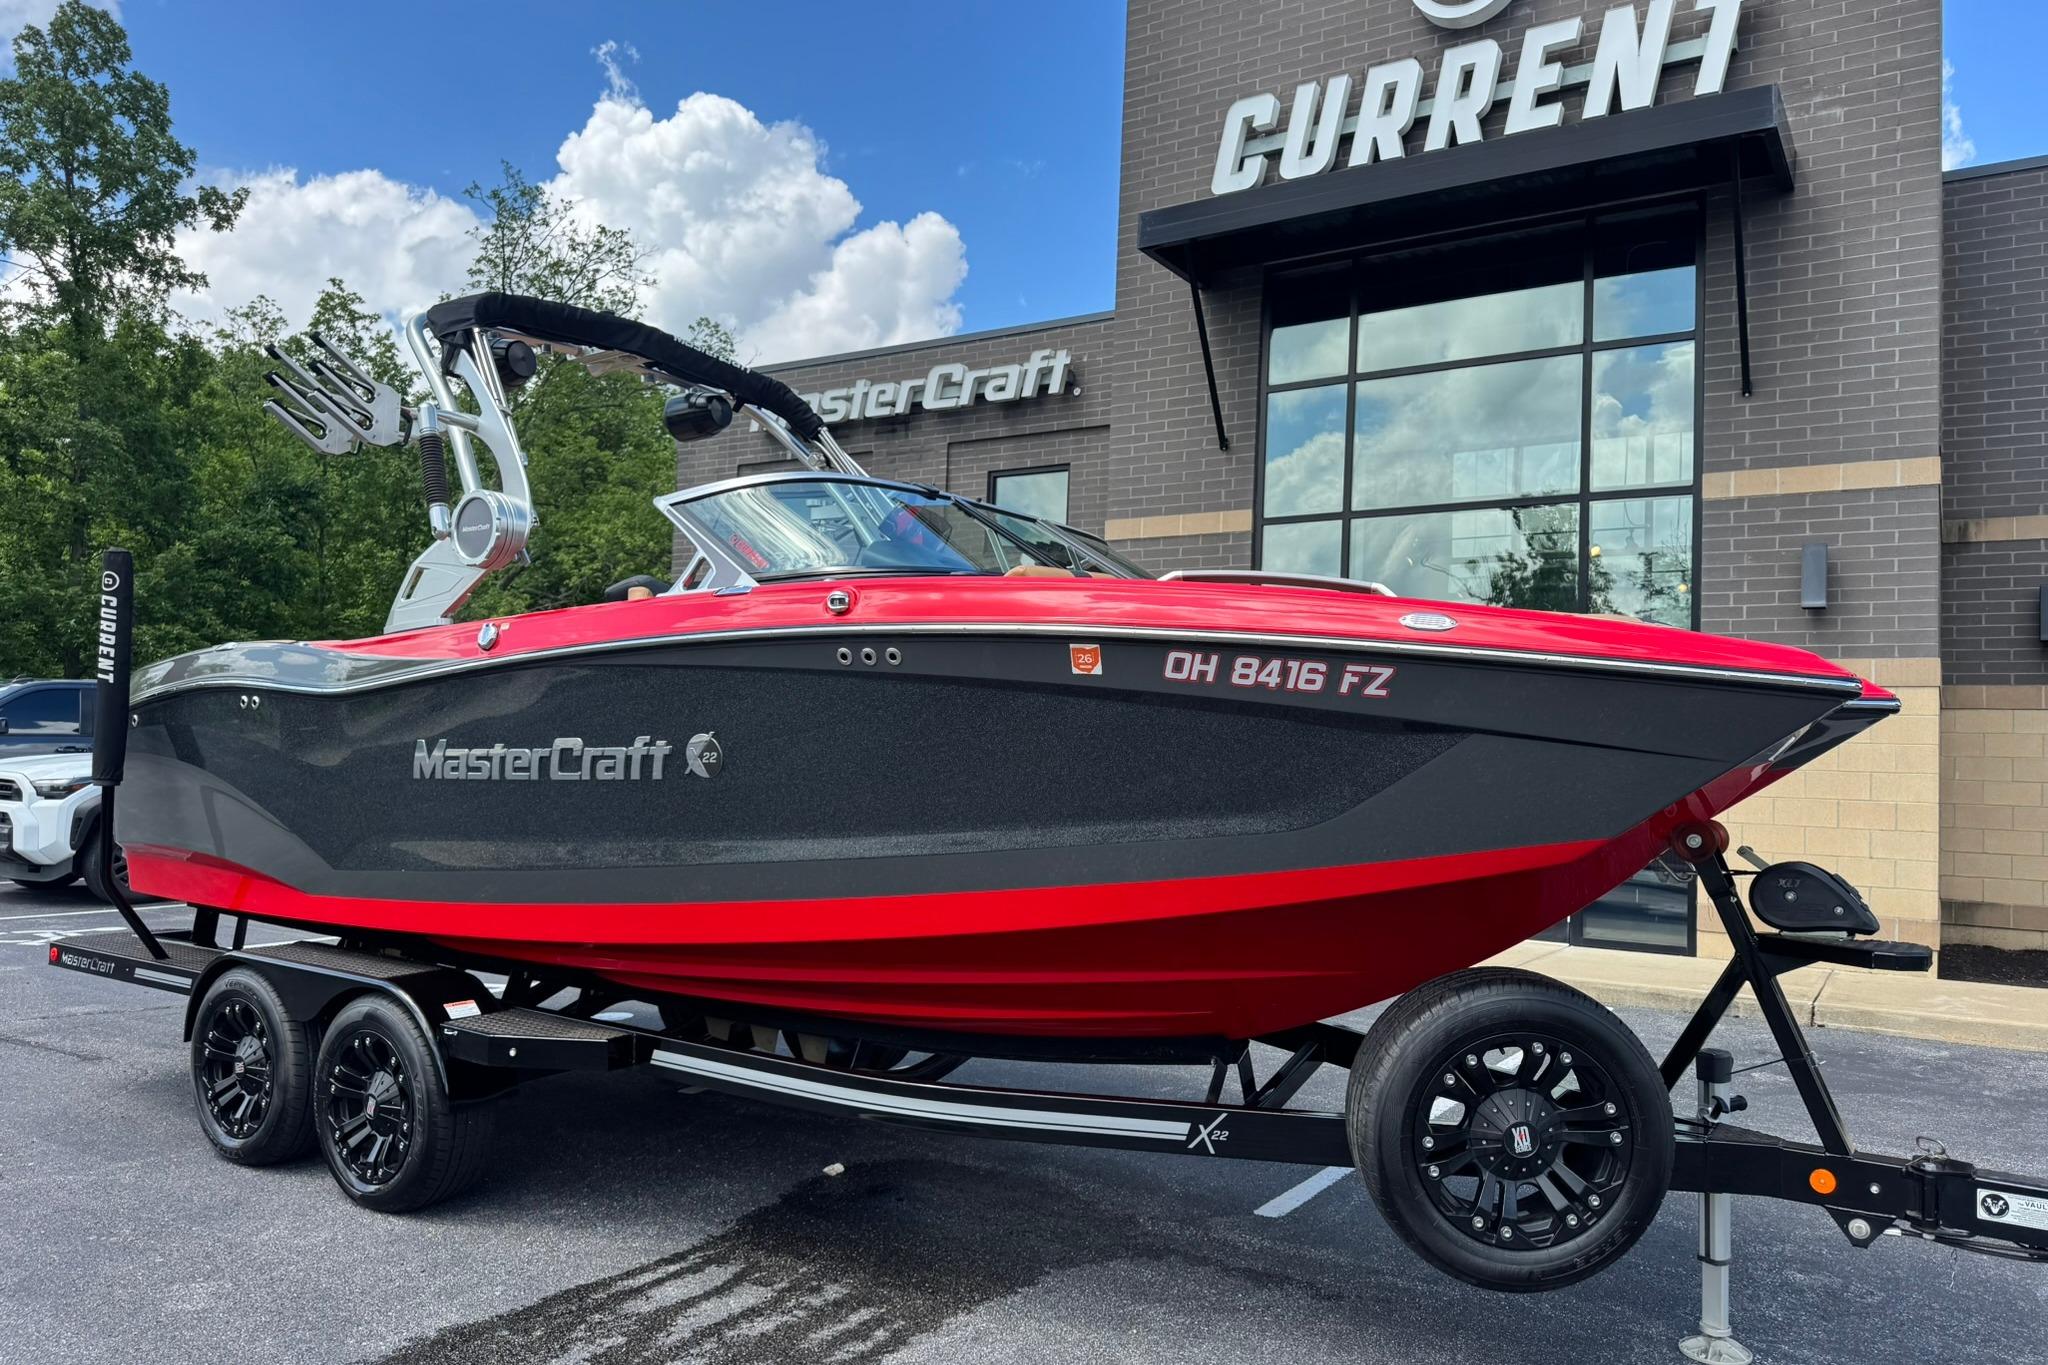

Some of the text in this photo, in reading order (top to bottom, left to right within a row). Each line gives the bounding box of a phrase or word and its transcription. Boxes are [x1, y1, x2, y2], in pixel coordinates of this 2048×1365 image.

[1211, 0, 1743, 195] CURRENT
[97, 594, 118, 684] CURRENT
[1077, 653, 1093, 664] 26
[1163, 650, 1396, 698] OH 8416 FZ
[412, 736, 673, 781] MasterCraft
[702, 751, 718, 764] 22
[61, 951, 116, 974] MasterCraft
[2025, 1201, 2048, 1211] VAUL
